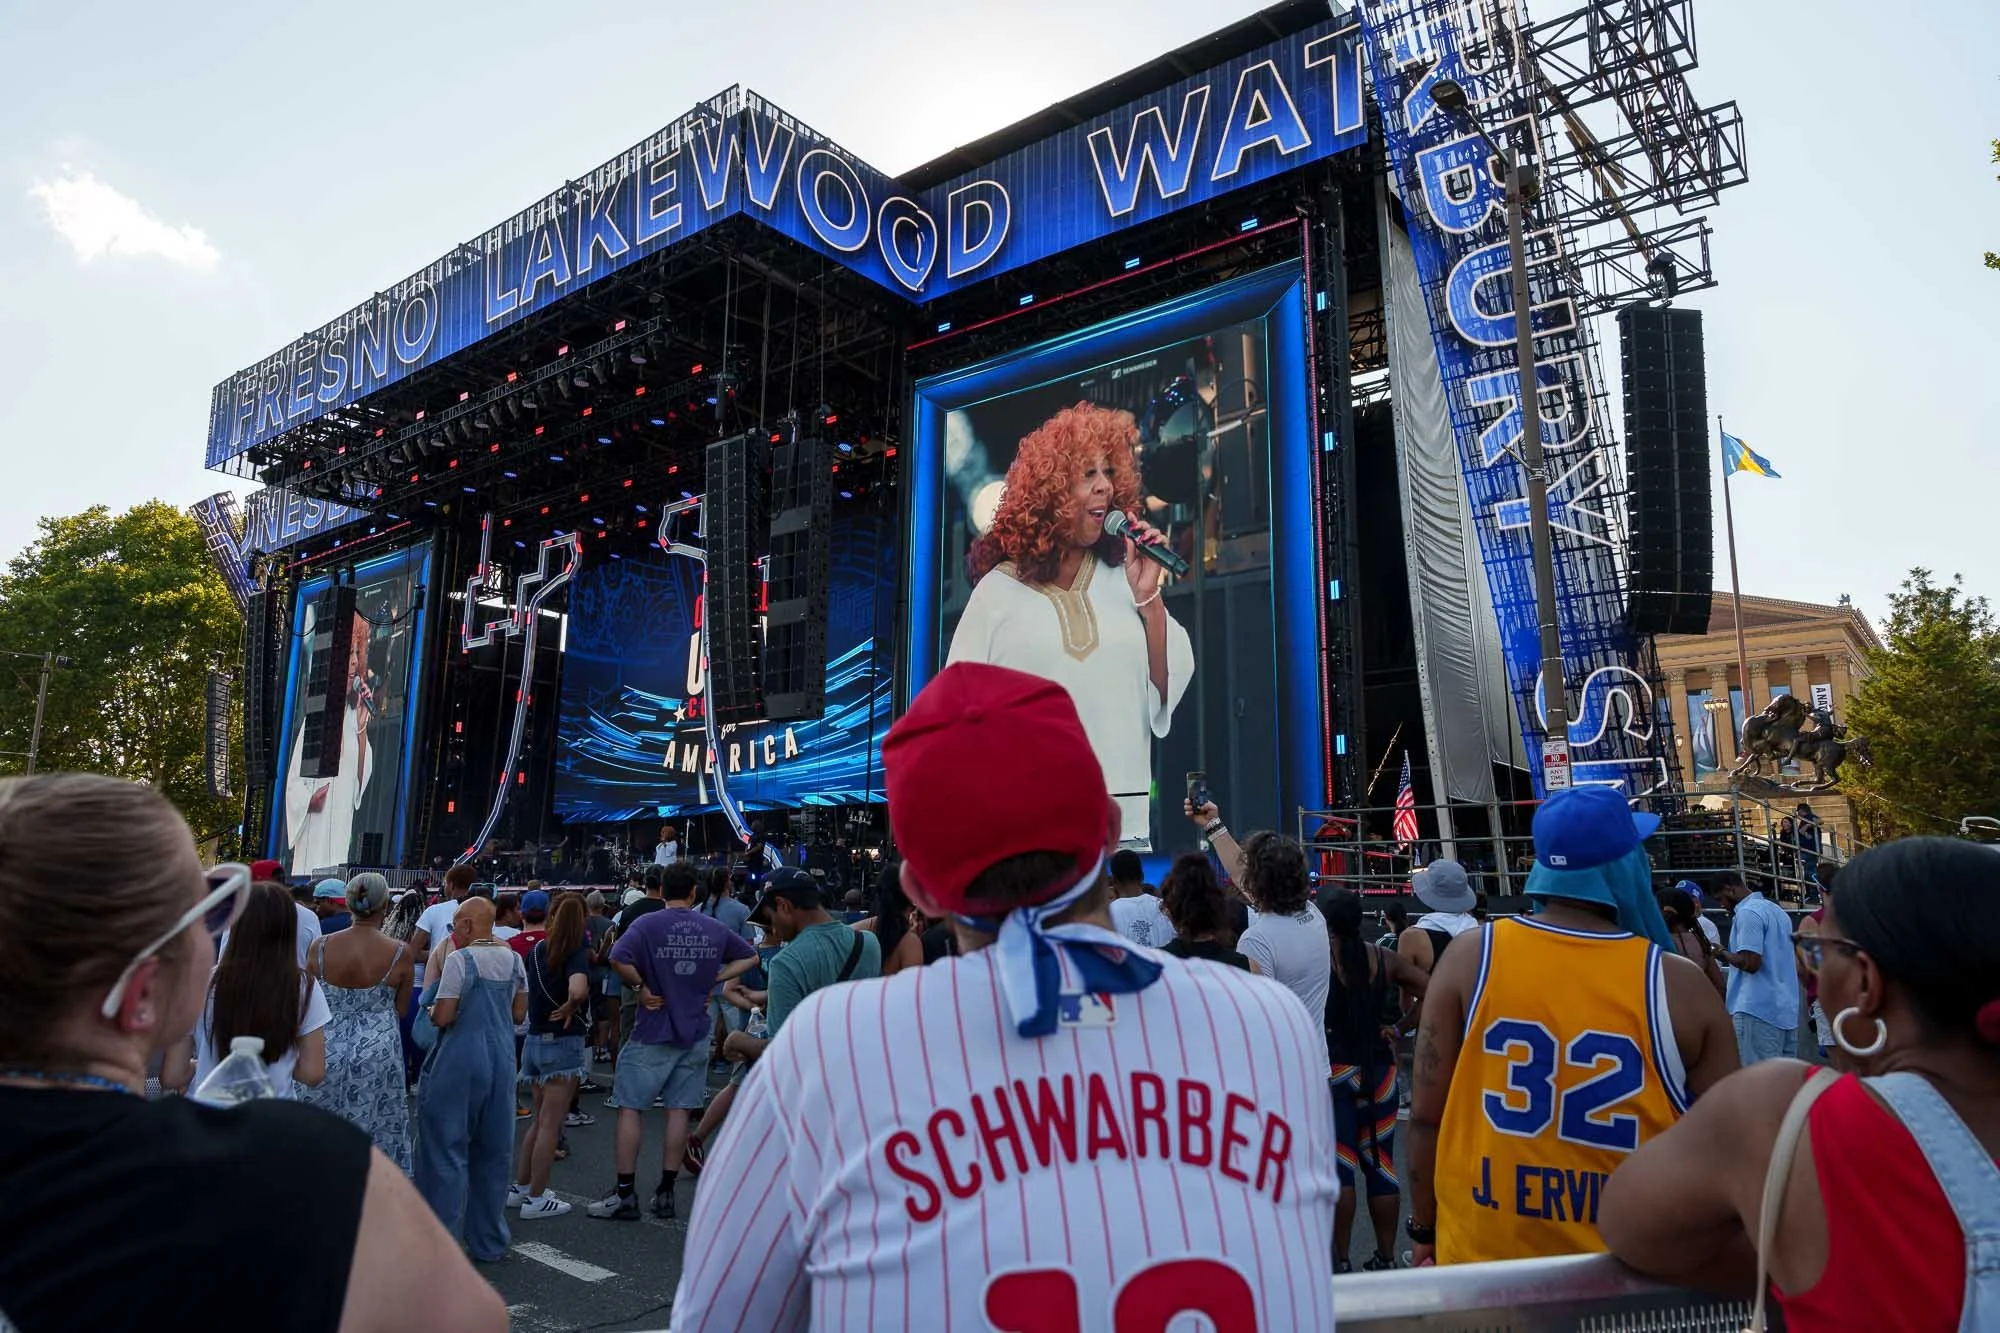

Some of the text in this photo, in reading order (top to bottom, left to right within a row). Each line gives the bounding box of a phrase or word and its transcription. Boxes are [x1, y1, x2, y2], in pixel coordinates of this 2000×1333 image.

[231, 279, 438, 447] FRESNO
[485, 96, 1011, 323] LAKEWOOD
[1375, 0, 1623, 549] RBURY
[720, 723, 737, 740] for
[1551, 754, 1560, 762] NO
[655, 947, 719, 959] ATHLETIC
[666, 934, 710, 946] EAGLE
[1482, 1017, 1645, 1153] 32
[884, 1072, 1293, 1224] SCHWARBER
[1472, 1156, 1609, 1225] J. ERVI
